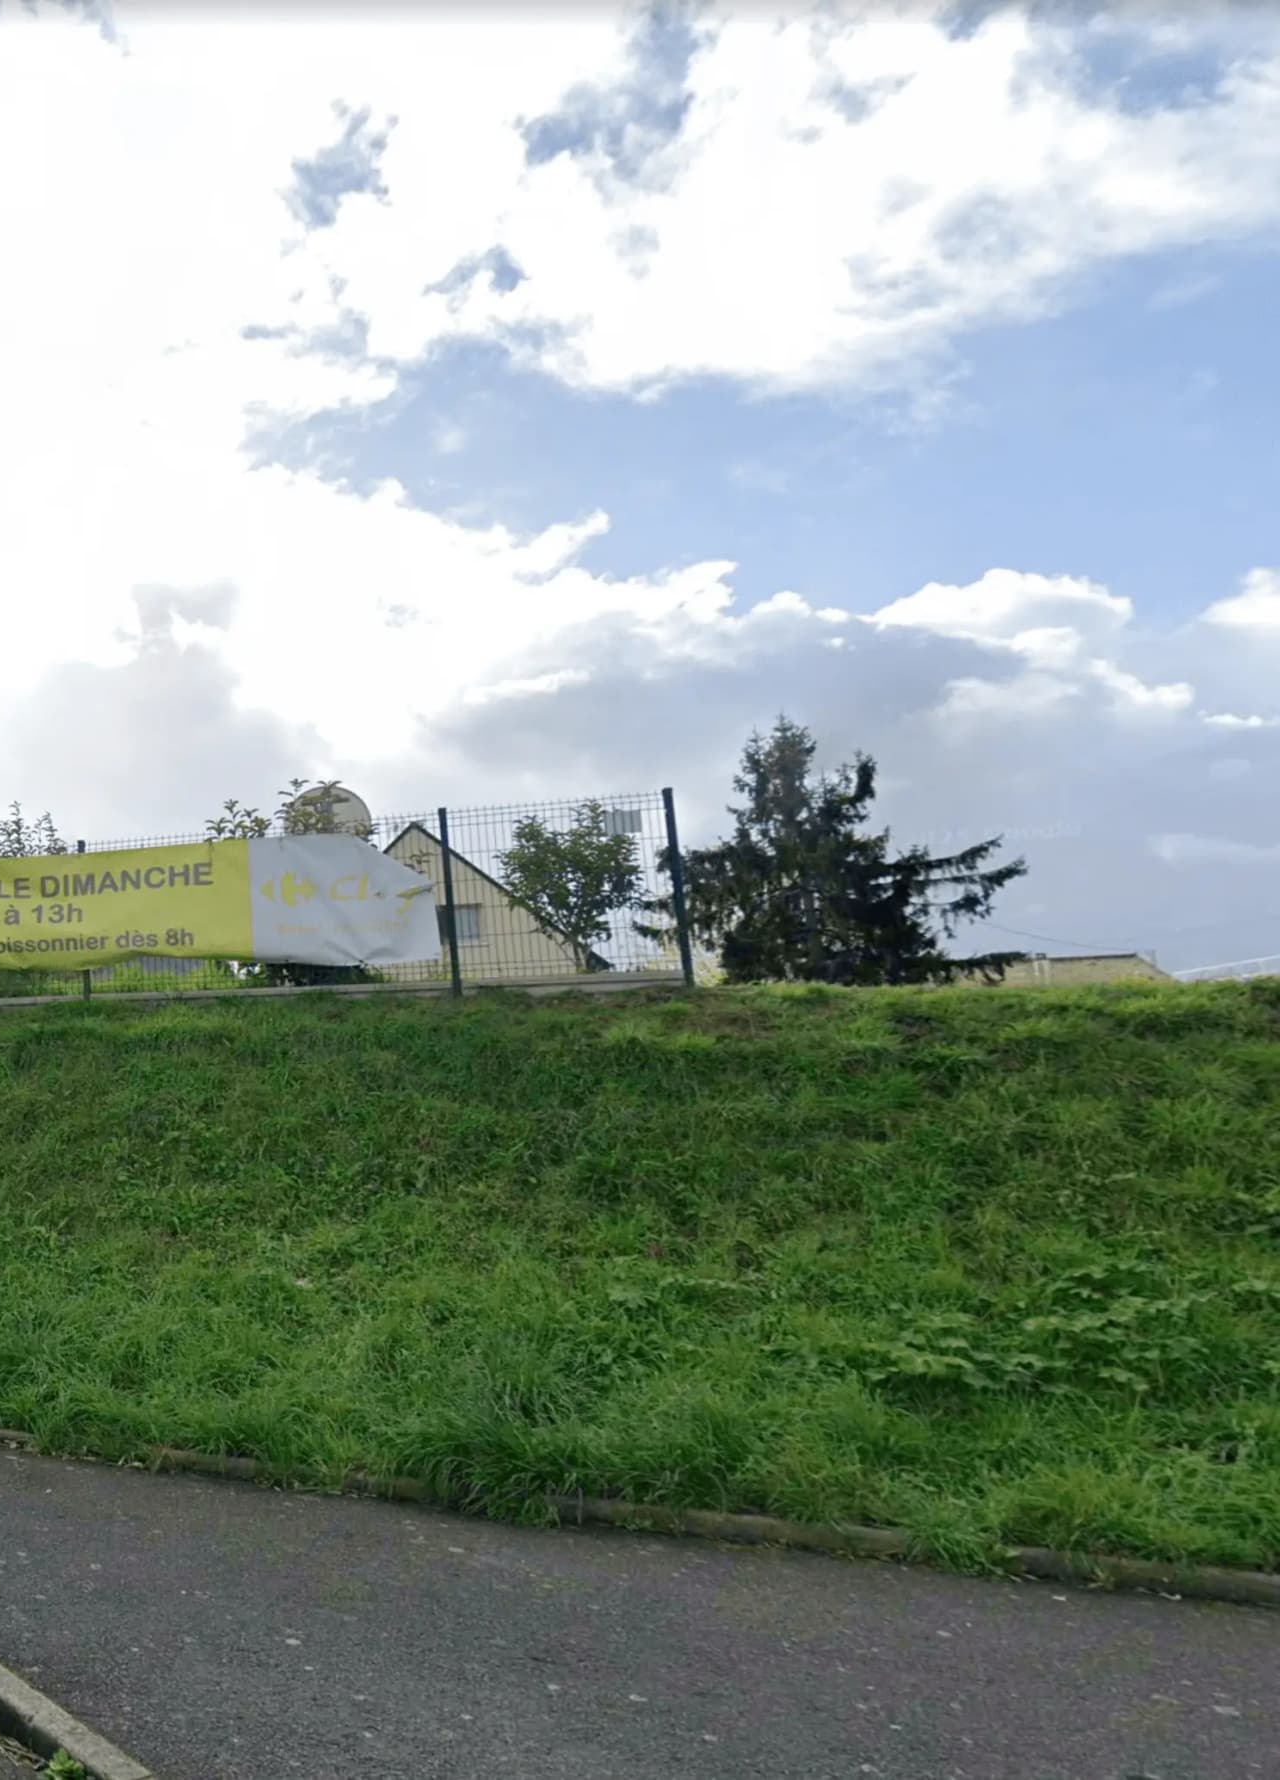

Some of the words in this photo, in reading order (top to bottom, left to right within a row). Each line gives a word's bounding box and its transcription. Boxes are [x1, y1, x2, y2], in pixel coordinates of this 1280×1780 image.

[40, 862, 214, 898] DIMANCHE
[4, 904, 20, 925] à
[32, 904, 83, 924] 13h
[115, 930, 158, 949] dès
[165, 928, 194, 946] 8h
